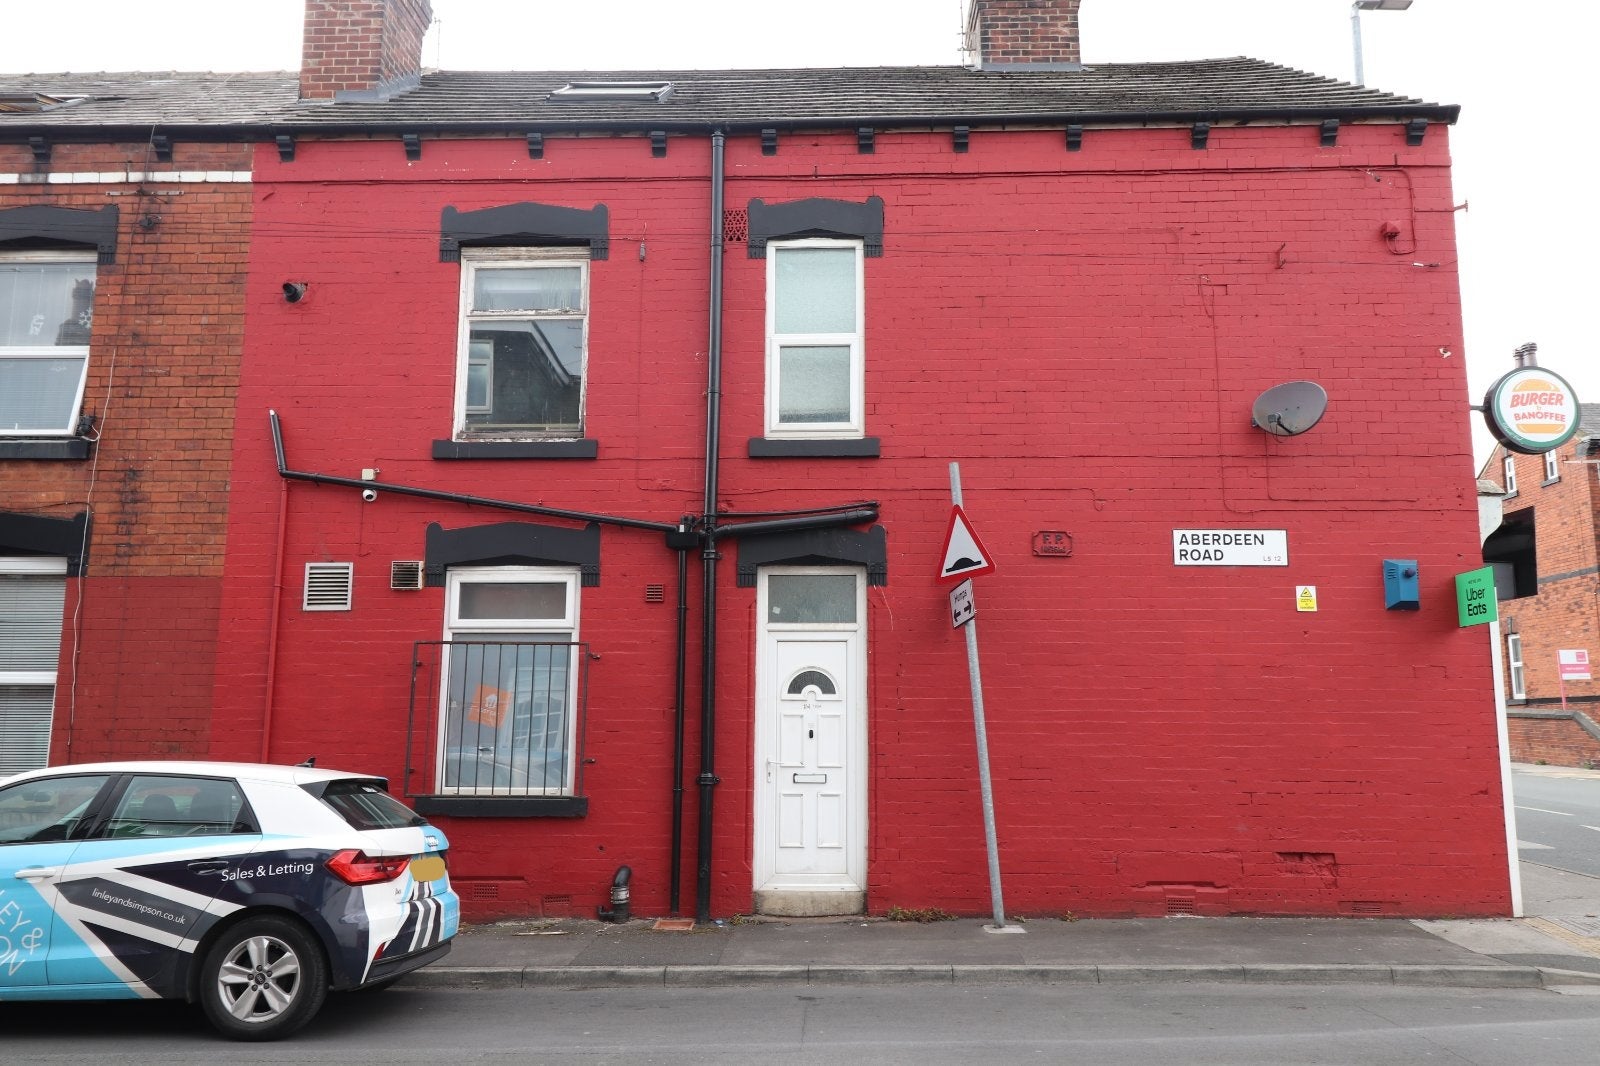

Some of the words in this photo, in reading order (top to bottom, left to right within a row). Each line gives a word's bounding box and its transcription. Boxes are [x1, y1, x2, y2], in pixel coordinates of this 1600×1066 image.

[1510, 392, 1564, 408] BURGER
[1513, 411, 1566, 422] BANOFFEE
[1179, 533, 1264, 545] ABERDEEN
[1179, 549, 1224, 561] ROAD
[1466, 588, 1485, 602] Uber
[1467, 603, 1487, 617] Eats
[221, 868, 254, 881] Sales
[256, 866, 266, 877] &
[268, 862, 314, 875] Letting
[92, 888, 186, 925] linleyandsimpson.co.uk
[21, 927, 44, 956] &
